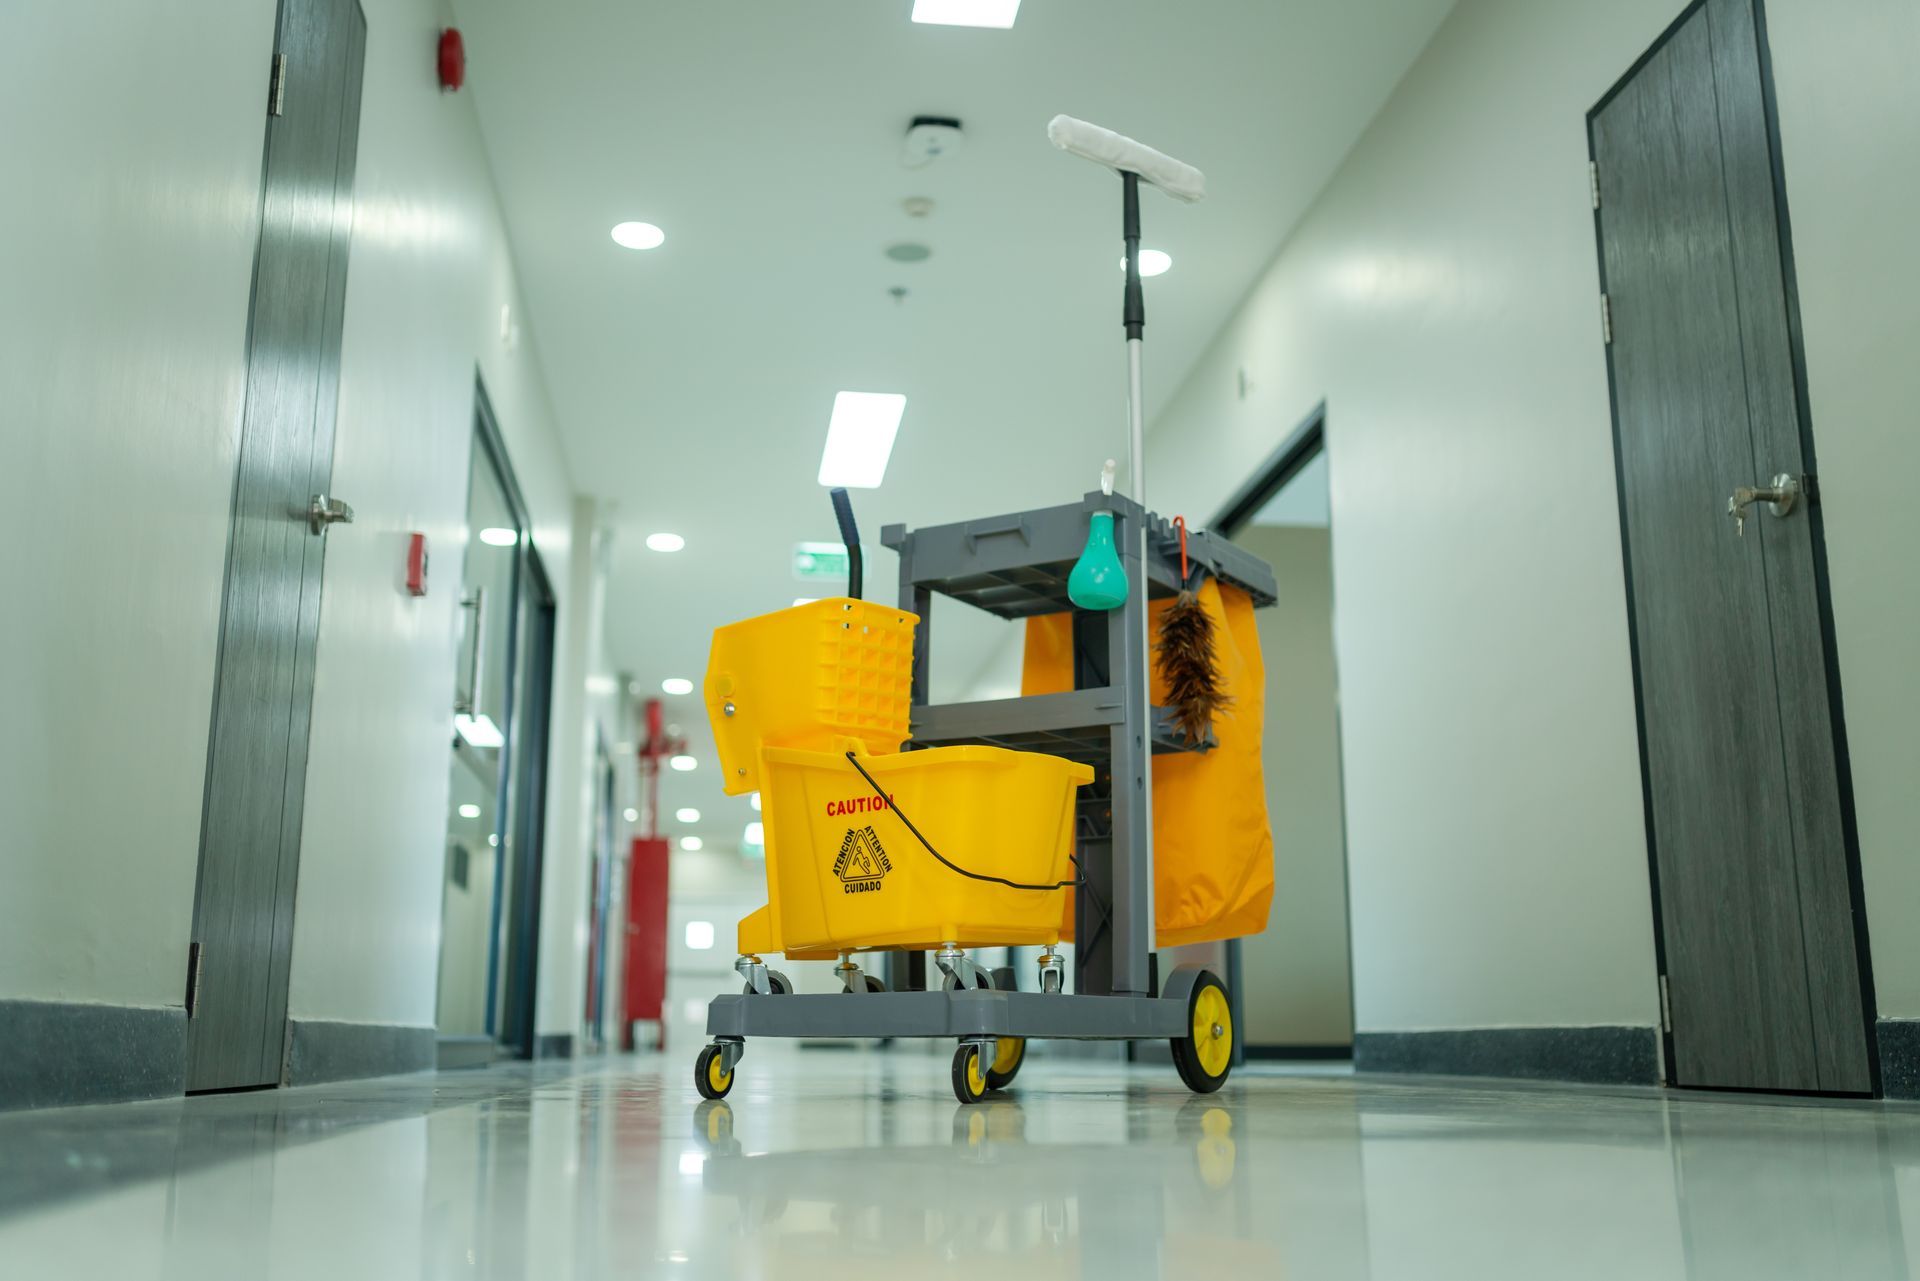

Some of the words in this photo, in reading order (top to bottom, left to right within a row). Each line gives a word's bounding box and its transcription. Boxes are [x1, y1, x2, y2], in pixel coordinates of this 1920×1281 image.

[832, 828, 855, 877] ATENCION
[864, 825, 893, 873] ATTENTION
[844, 881, 881, 894] CUIDADO
